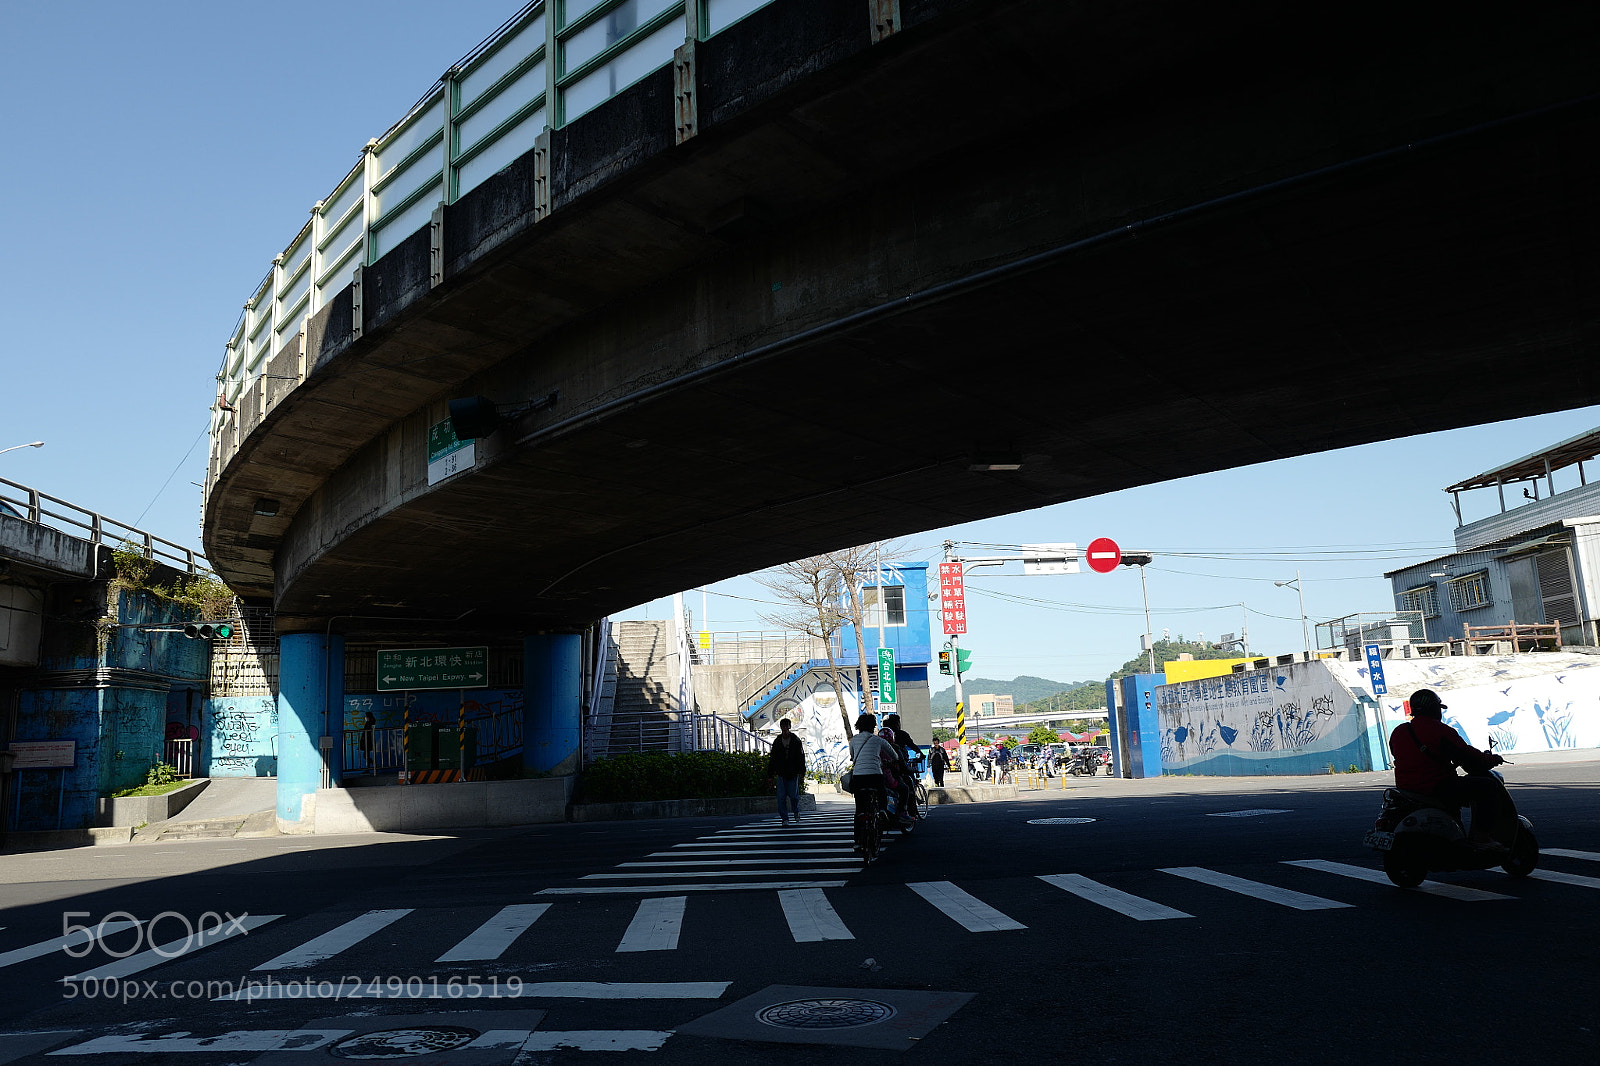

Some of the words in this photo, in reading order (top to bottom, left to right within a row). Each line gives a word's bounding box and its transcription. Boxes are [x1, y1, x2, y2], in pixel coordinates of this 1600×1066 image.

[941, 565, 955, 632] 禁止車輛駛入
[951, 565, 965, 632] 水門單行駛出
[405, 655, 462, 668] 新北環快
[882, 661, 892, 691] 台北市
[418, 674, 439, 682] Taipei
